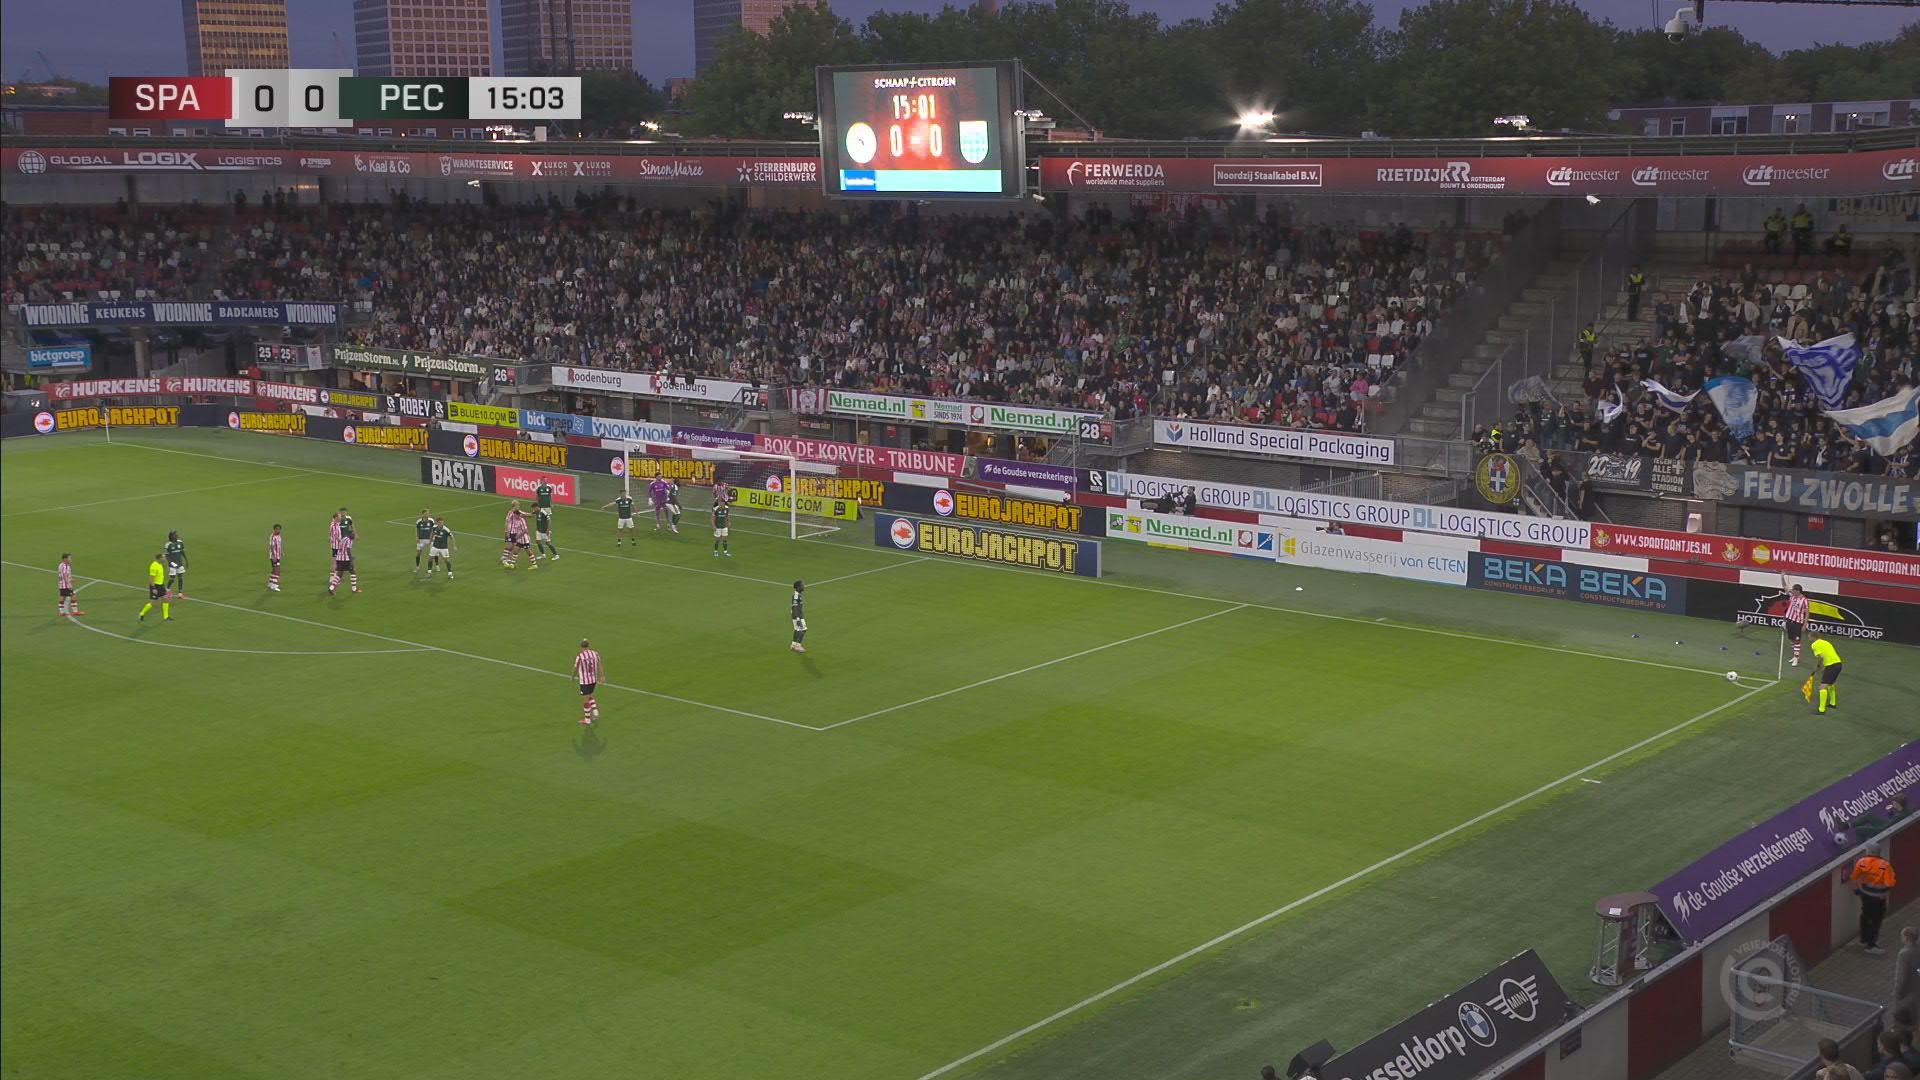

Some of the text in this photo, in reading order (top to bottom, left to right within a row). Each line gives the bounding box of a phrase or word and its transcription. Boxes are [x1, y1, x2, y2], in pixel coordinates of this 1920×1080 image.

[892, 94, 936, 120] 15:01
[50, 152, 282, 167] GLOBAL LOGIX LOGISTICS
[369, 159, 410, 173] Kaal & Co
[452, 158, 513, 170] WARMTESERVICE
[544, 161, 568, 169] LUXOR
[586, 161, 611, 169] LUXOR
[754, 162, 817, 172] STERRENBURG
[754, 173, 817, 182] SCHILDERWERK
[1085, 164, 1165, 177] FERWERDA
[1217, 170, 1318, 182] Noordzij Staalkabel B.V.
[1377, 168, 1451, 182] RIETDIJK
[1549, 166, 1620, 182] ritmeester
[1635, 166, 1710, 181] ritmeester
[1748, 164, 1830, 180] ritmeester
[1085, 178, 1117, 186] worldwide
[1136, 178, 1165, 188] suppliers
[25, 303, 336, 325] WOONING KEUKENS WOONING BADKAMERS WOONING
[30, 349, 85, 364] bictgroep
[258, 347, 271, 358] 25
[494, 368, 507, 381] 26
[567, 368, 622, 387] Roodenburg
[73, 379, 160, 397] HURKENS
[183, 378, 250, 394] HURKENS
[266, 384, 317, 402] HURKENS
[400, 397, 430, 416] ROBEY
[743, 391, 759, 405] 27
[829, 390, 905, 413] Nemad.nl
[934, 402, 962, 410] Nemad
[460, 408, 506, 421] BLUE10.COM
[991, 406, 1079, 428] Nemad.nl
[690, 432, 711, 443] Goudse
[1081, 422, 1100, 439] 28
[1190, 426, 1390, 461] Holland Special Packaging
[480, 438, 567, 468] EUROJACKPOT
[764, 438, 793, 456] BOK
[796, 440, 814, 458] DE
[818, 443, 875, 465] KORVER
[888, 451, 956, 475] TRIBUNE
[431, 459, 486, 492] BASTA
[992, 464, 1077, 484] de Goudse verzekeringen
[1652, 465, 1672, 474] ALLE
[504, 476, 568, 496] videolnd.
[1743, 471, 1910, 514] FEU ZWOLLE
[750, 492, 822, 513] BLUE10COM
[956, 491, 1082, 532] EUROJACKPOT
[1130, 479, 1190, 498] LOGISTIC
[1202, 487, 1250, 507] GROUP
[1277, 496, 1350, 520] LOGISTICS
[1355, 503, 1410, 525] GROUP
[1440, 512, 1521, 538] LOGISTICS
[1528, 522, 1589, 545] GROUP
[1146, 518, 1232, 542] Nemad.nl
[918, 521, 1078, 573] EUROJACKPOT
[1301, 541, 1466, 573] Glazenwasserij van ELTEN
[1484, 557, 1567, 588] BEKA
[1579, 569, 1667, 601] BEKA
[1737, 613, 1769, 627] HOTEL
[1843, 789, 1883, 817] Goudse
[1689, 826, 1814, 911] de Goudse verzekeringen
[1507, 990, 1528, 1010] MINI
